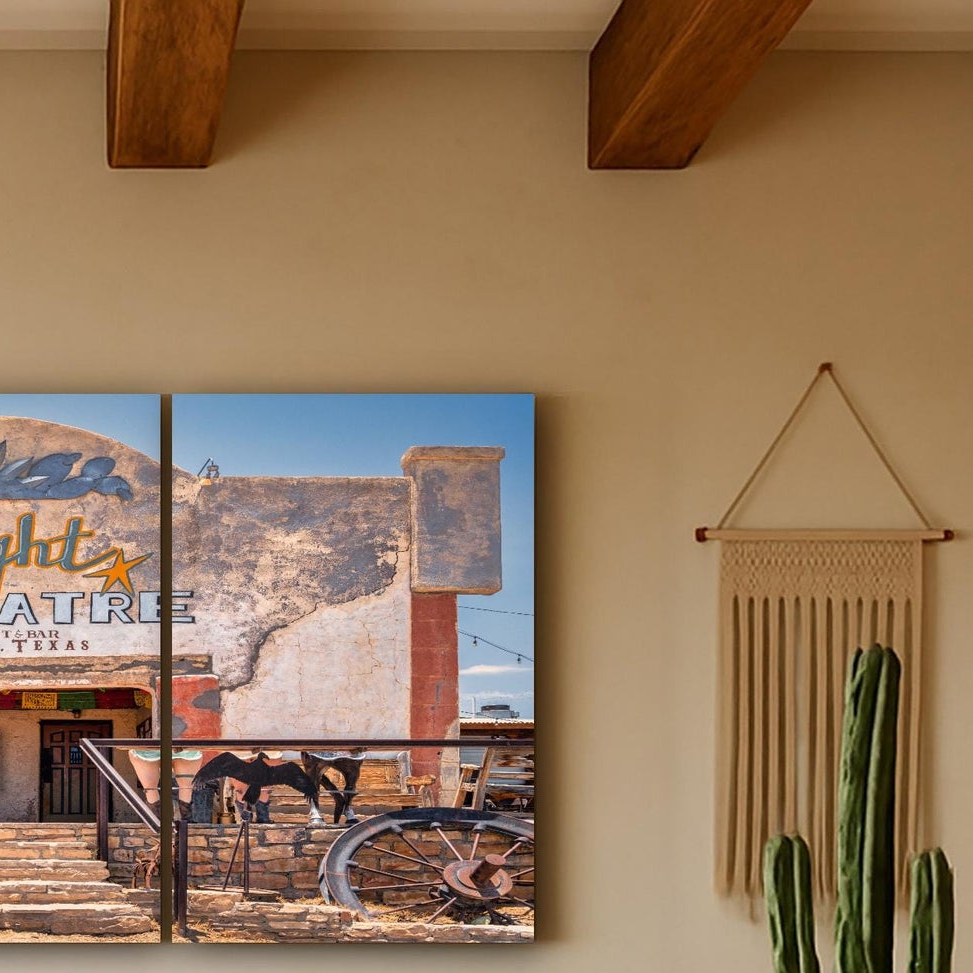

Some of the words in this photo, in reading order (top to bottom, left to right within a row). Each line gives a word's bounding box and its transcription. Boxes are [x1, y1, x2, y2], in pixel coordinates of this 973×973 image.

[14, 629, 24, 639] &
[27, 630, 60, 640] BAR
[11, 638, 90, 652] TEXAS
